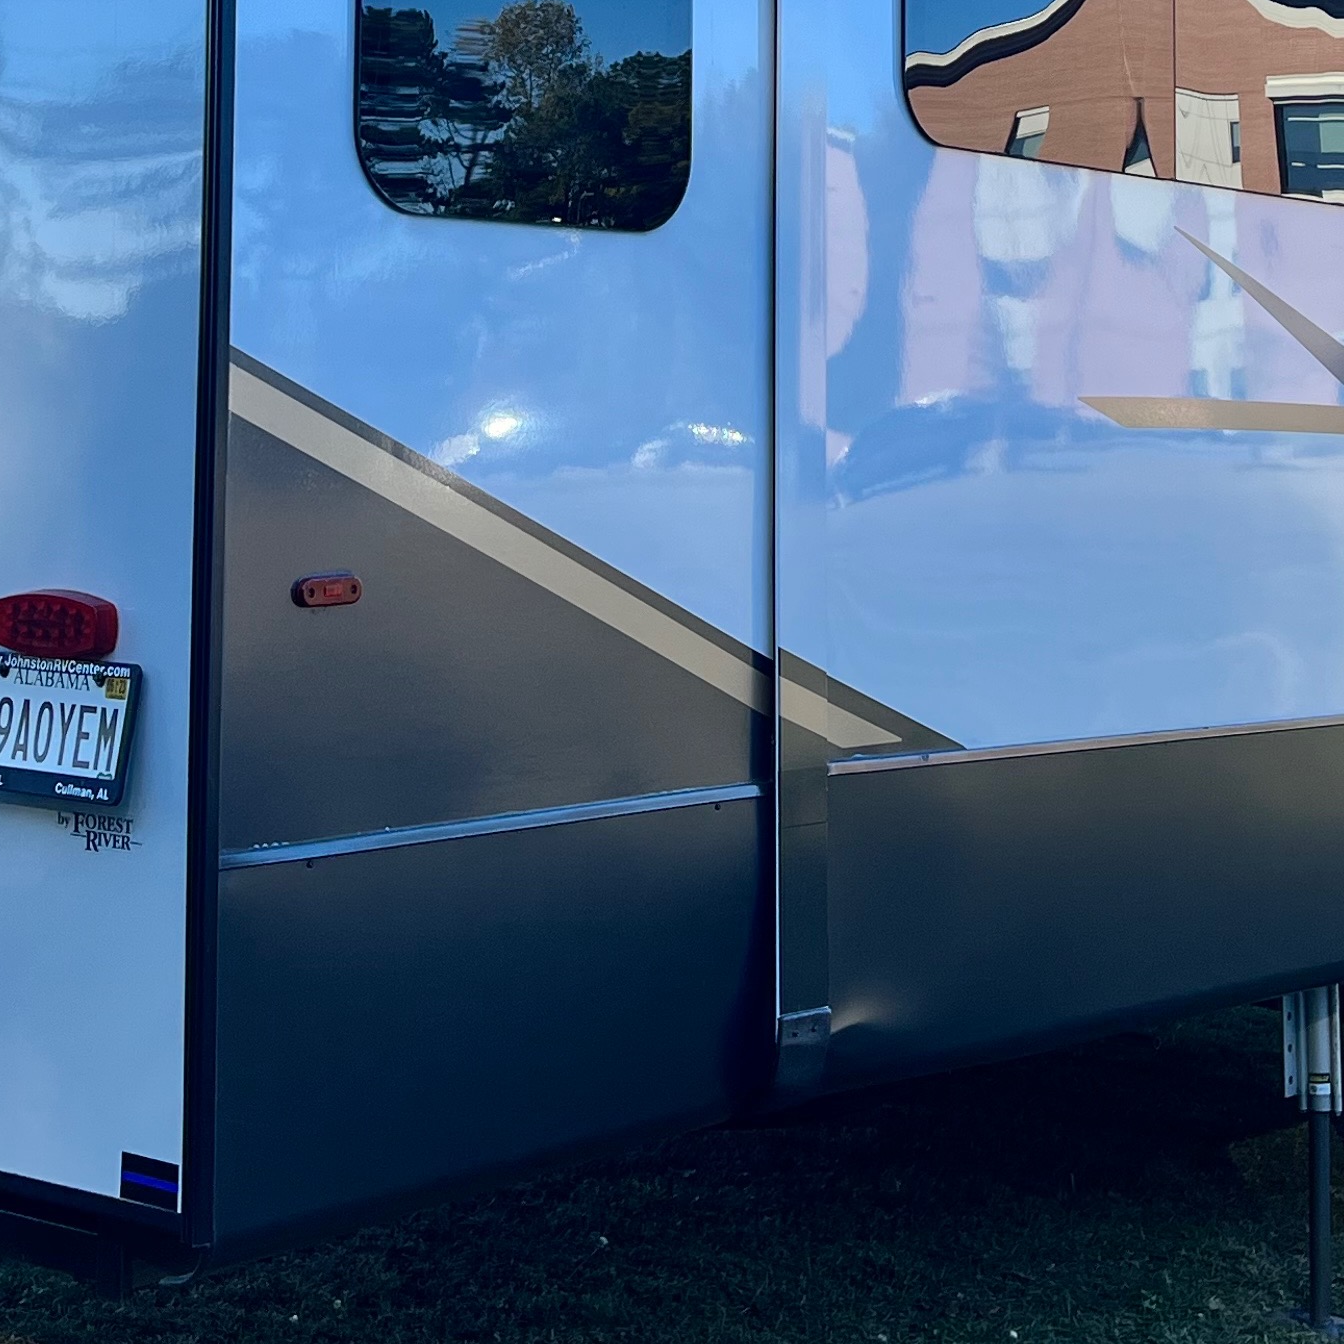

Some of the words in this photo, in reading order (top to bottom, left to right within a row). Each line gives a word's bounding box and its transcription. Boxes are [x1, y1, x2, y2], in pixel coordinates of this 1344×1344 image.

[13, 670, 91, 691] ALABAMA
[55, 783, 95, 800] Cullman,
[96, 788, 109, 801] AL
[58, 813, 70, 829] by
[73, 812, 133, 834] FOREST
[85, 830, 131, 852] RIVER
